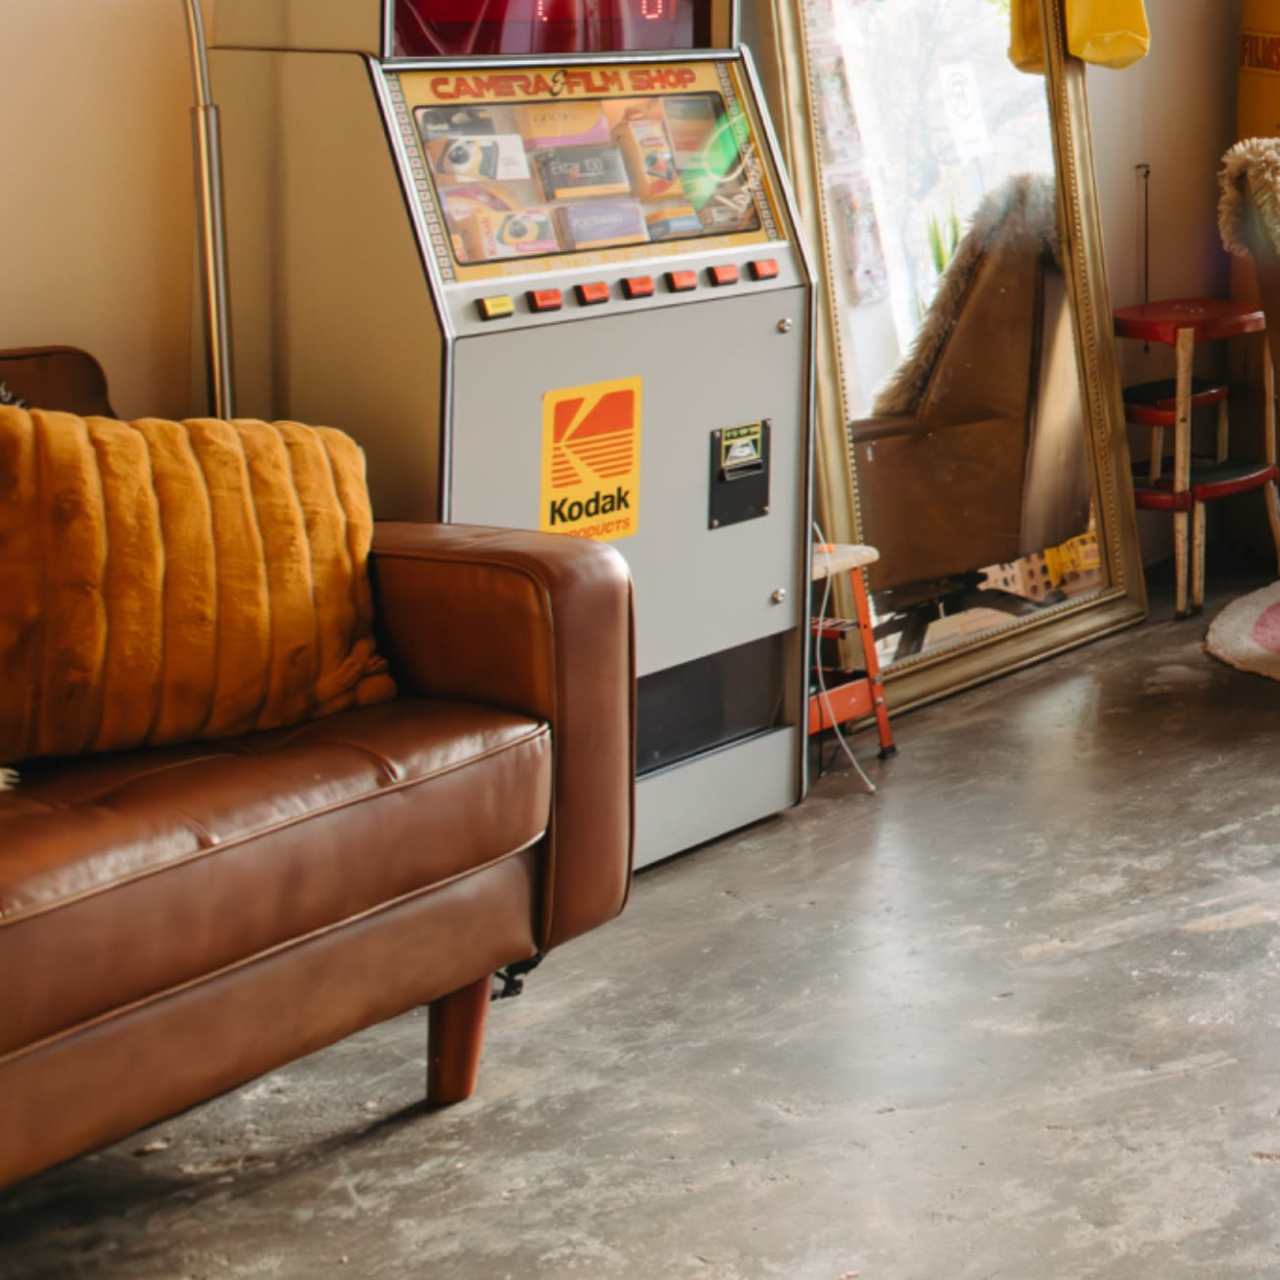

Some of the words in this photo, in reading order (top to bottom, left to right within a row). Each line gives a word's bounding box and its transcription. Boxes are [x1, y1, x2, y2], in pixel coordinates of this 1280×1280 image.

[430, 74, 553, 100] CAMERA
[564, 71, 623, 94] FILM
[629, 68, 697, 91] SHOP
[549, 486, 630, 526] Kodak
[565, 518, 630, 541] RODUCTS
